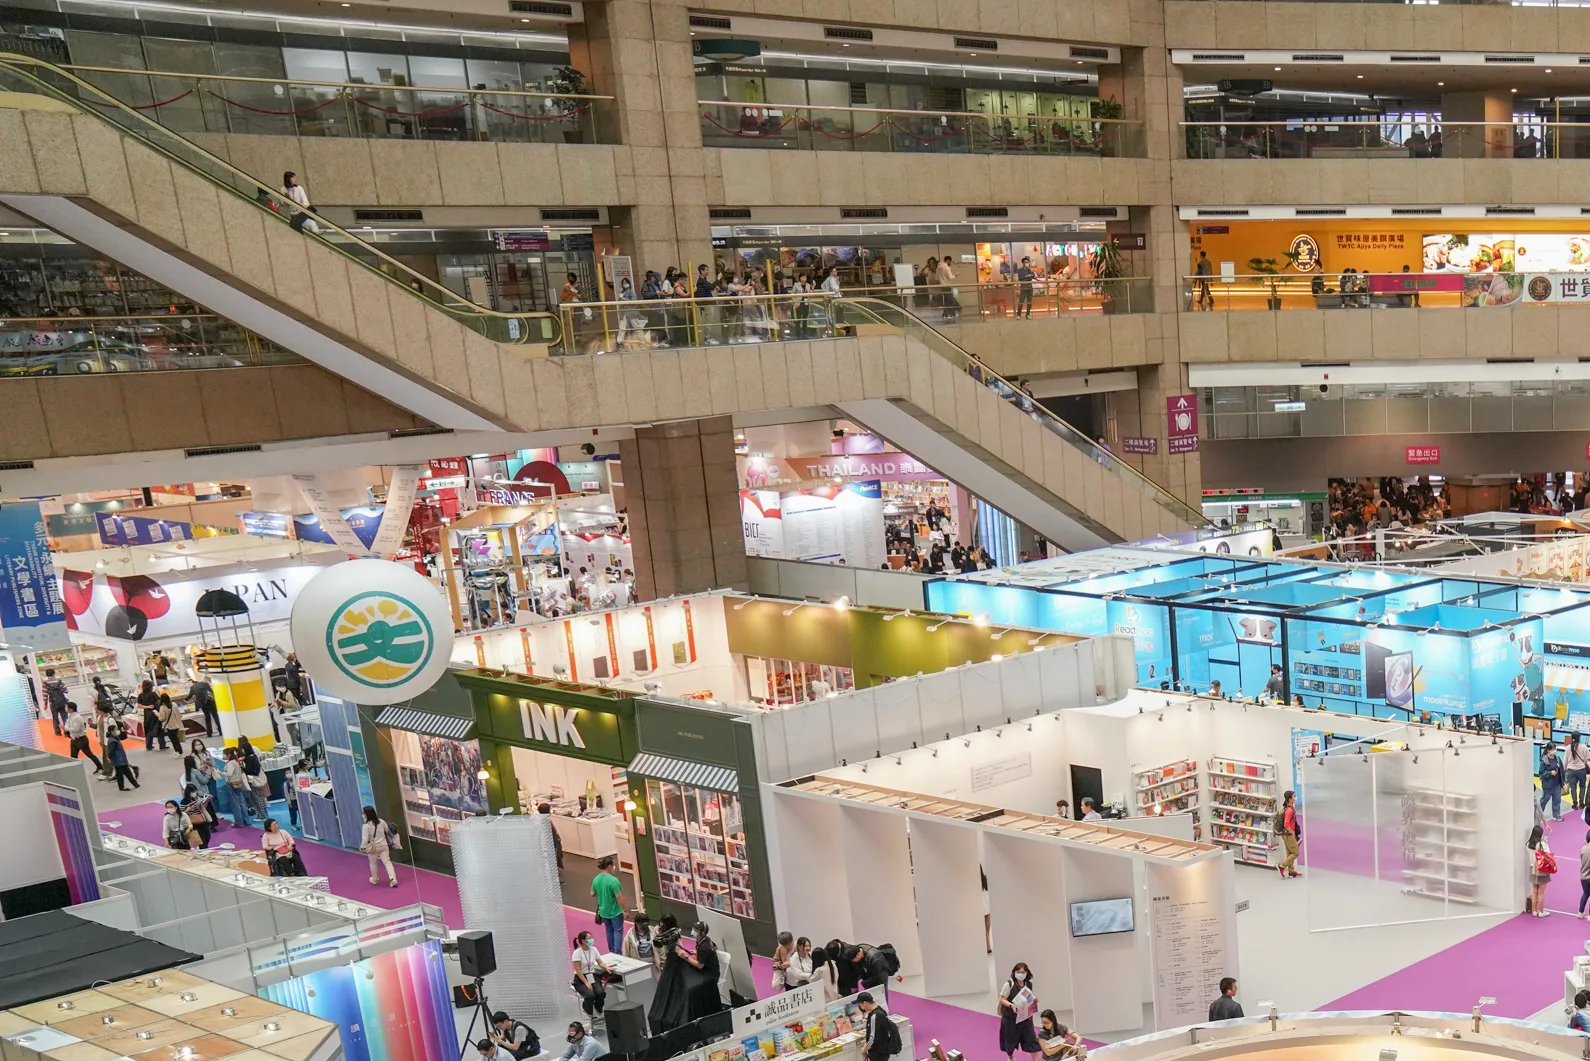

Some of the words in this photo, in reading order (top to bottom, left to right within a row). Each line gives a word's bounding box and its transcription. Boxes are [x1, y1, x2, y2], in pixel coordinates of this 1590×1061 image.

[1408, 449, 1438, 457] 緊急出口
[806, 462, 896, 479] THAILAND
[518, 699, 586, 749] INK
[763, 988, 813, 1018] 誠品書店
